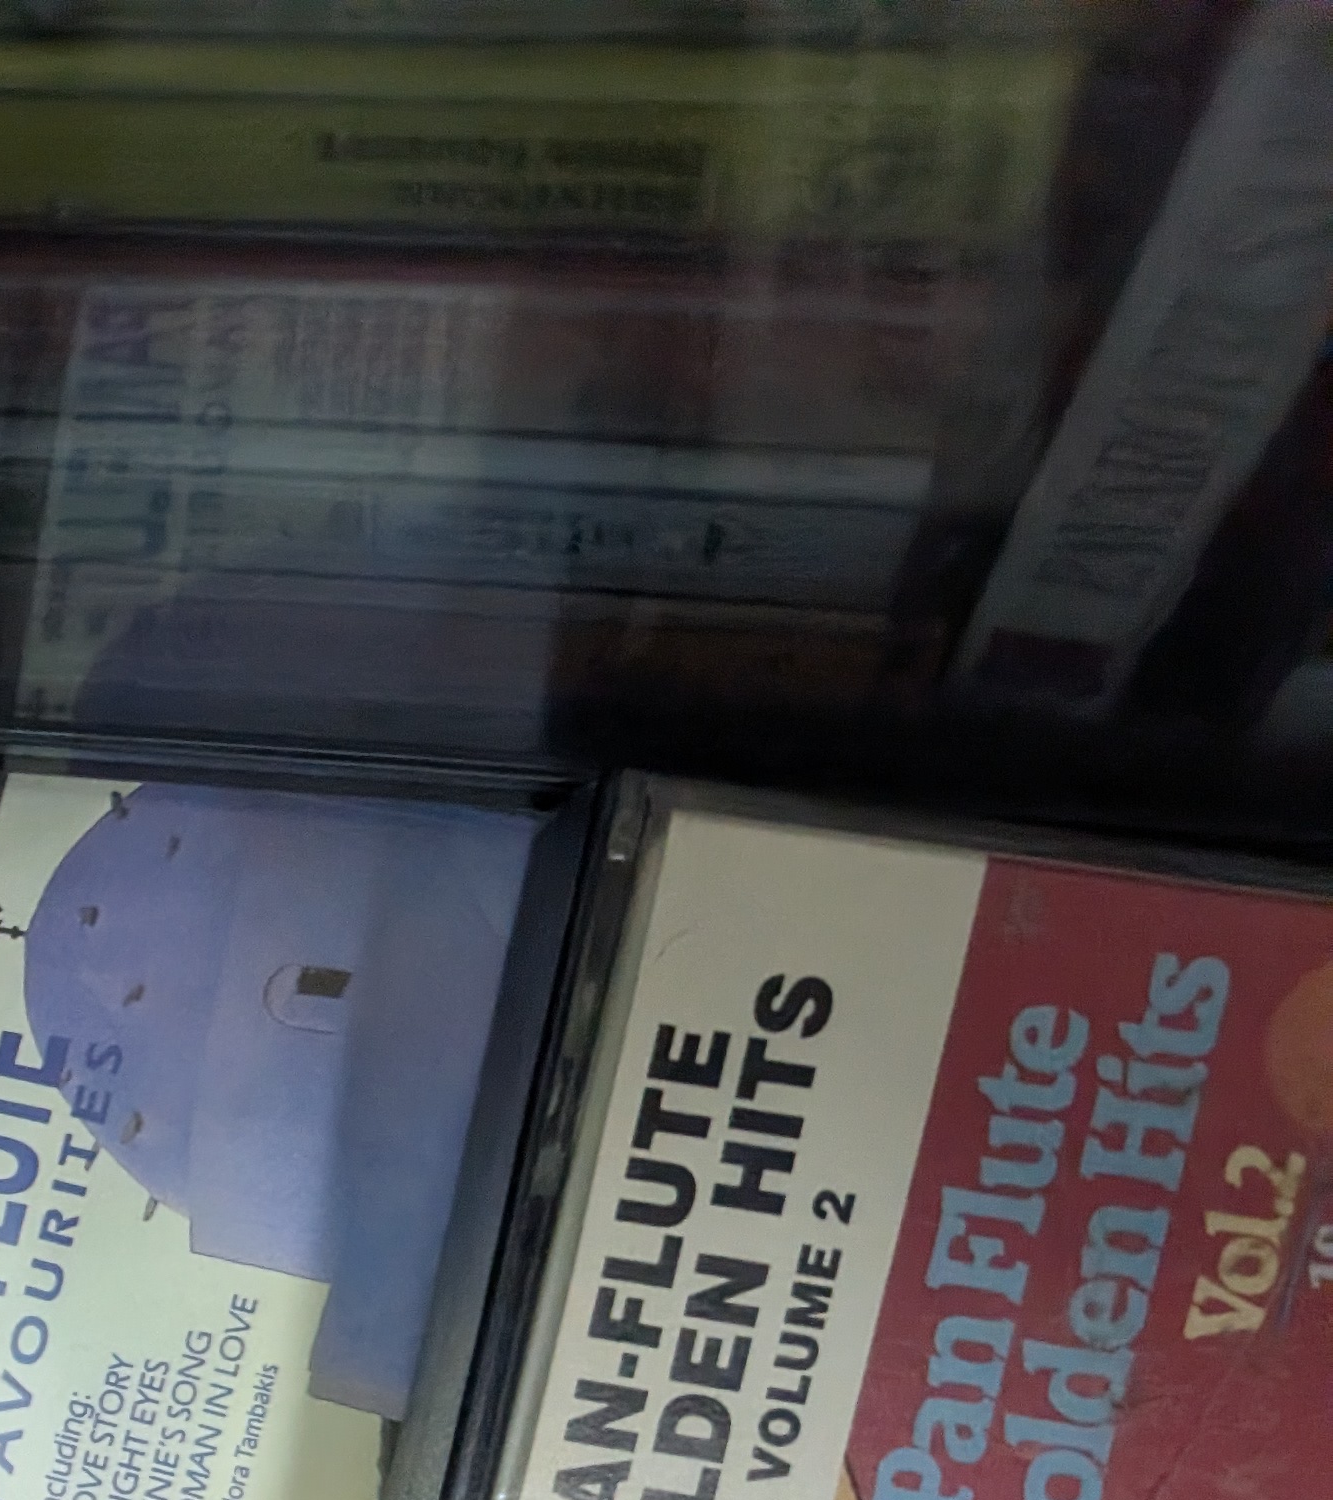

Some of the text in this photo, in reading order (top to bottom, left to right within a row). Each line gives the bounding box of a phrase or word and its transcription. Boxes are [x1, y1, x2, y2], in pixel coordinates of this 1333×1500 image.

[711, 974, 834, 1216] HITS
[1080, 952, 1231, 1192] Hits
[926, 1005, 1090, 1306] Flute
[136, 1358, 170, 1426] EYES
[171, 1330, 213, 1421] SONG
[203, 1382, 233, 1418] IN
[219, 1293, 258, 1377] LOVE
[747, 1190, 857, 1482] VOLUME 2
[93, 1352, 136, 1447] STORY
[234, 1363, 279, 1461] Tambakis
